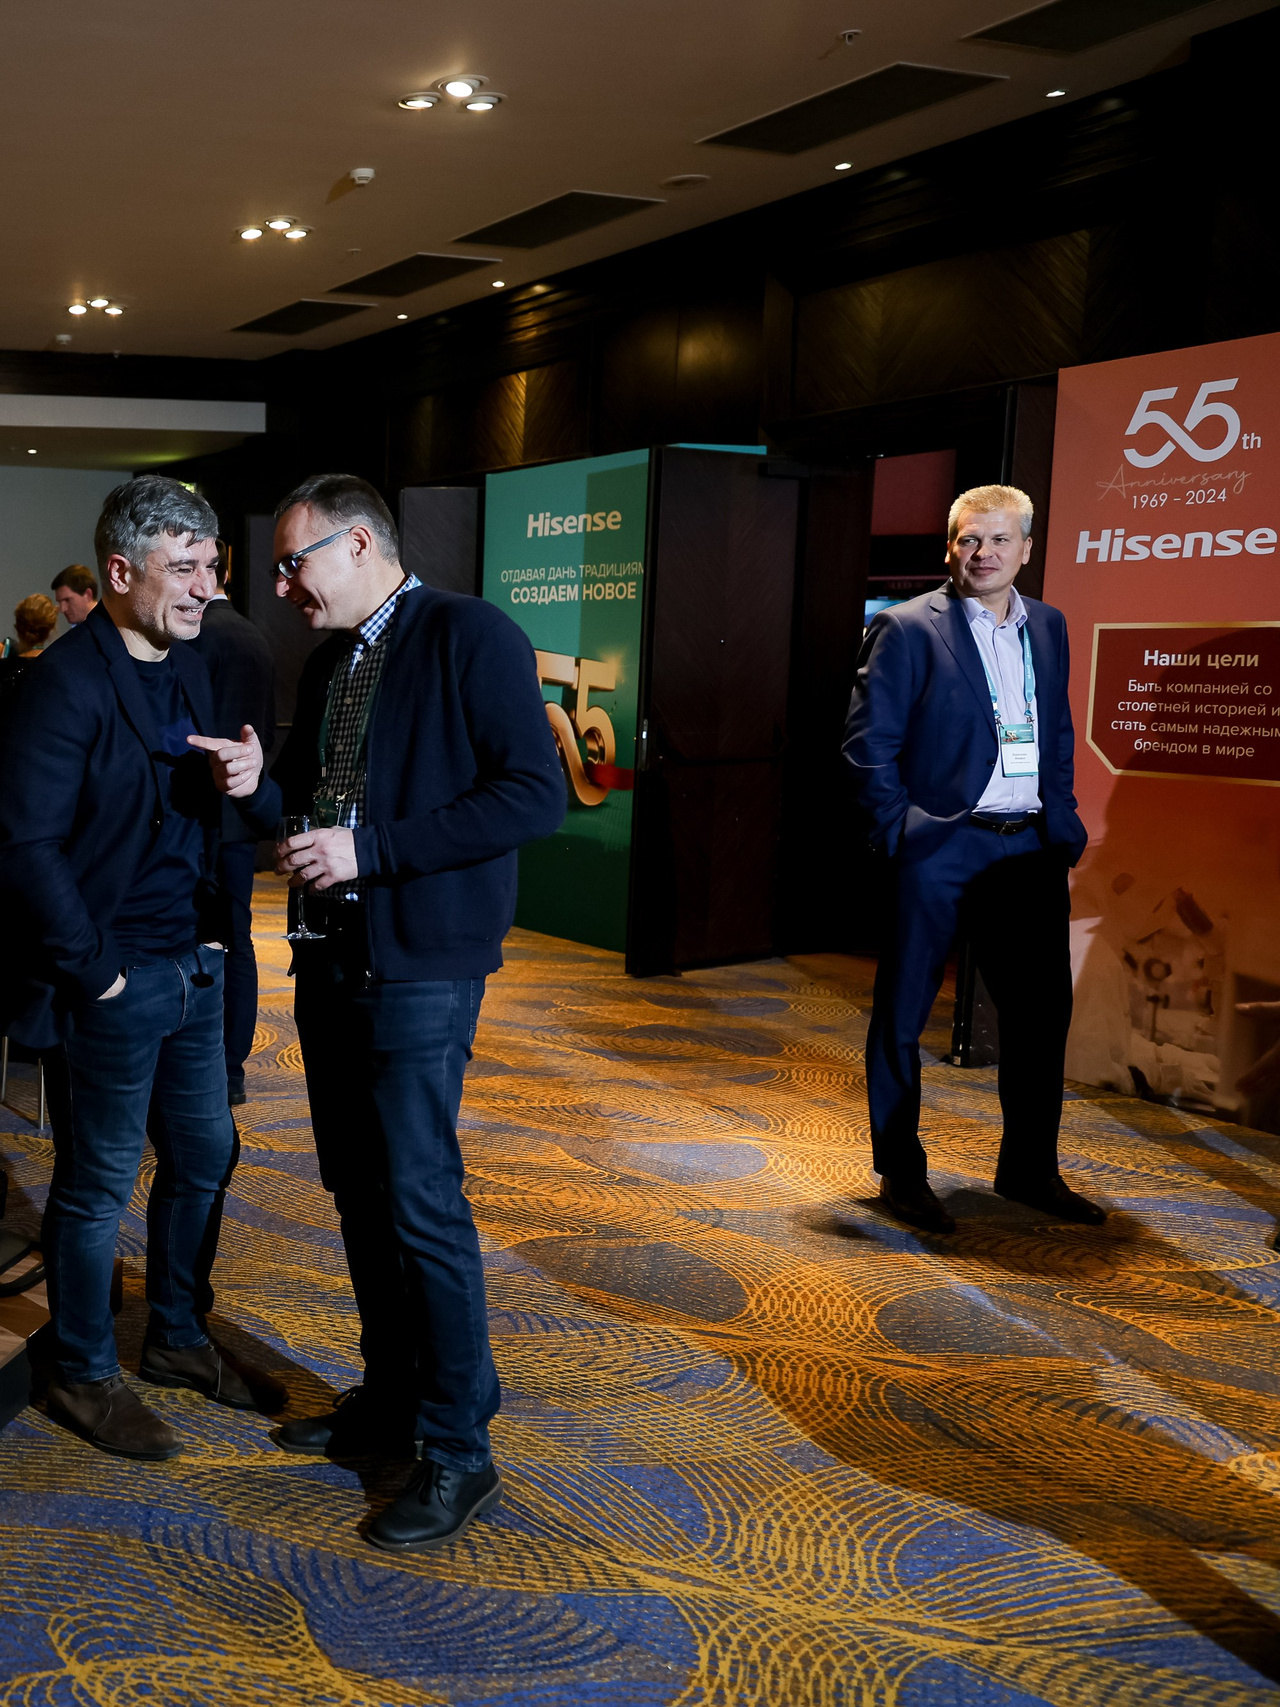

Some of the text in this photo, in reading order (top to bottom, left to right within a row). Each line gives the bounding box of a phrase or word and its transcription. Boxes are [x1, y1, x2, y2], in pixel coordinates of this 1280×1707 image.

[1096, 463, 1252, 501] Anniversary
[1132, 492, 1168, 509] 1969
[1185, 487, 1227, 505] 2024
[527, 510, 622, 538] Hisense
[1075, 527, 1278, 564] Hisense
[500, 567, 546, 583] ОТДАВАЯ
[547, 566, 577, 580] ДАНЬ
[510, 581, 637, 606] СОЗДАЕМ НОВОЕ
[1143, 649, 1260, 669] Наши цели
[1127, 679, 1273, 695] Быть компанией со
[1117, 700, 1190, 714] столетней
[1194, 703, 1266, 717] историей
[1110, 719, 1147, 731] стать
[1150, 721, 1199, 734] самым
[1133, 738, 1255, 759] брендом в мире
